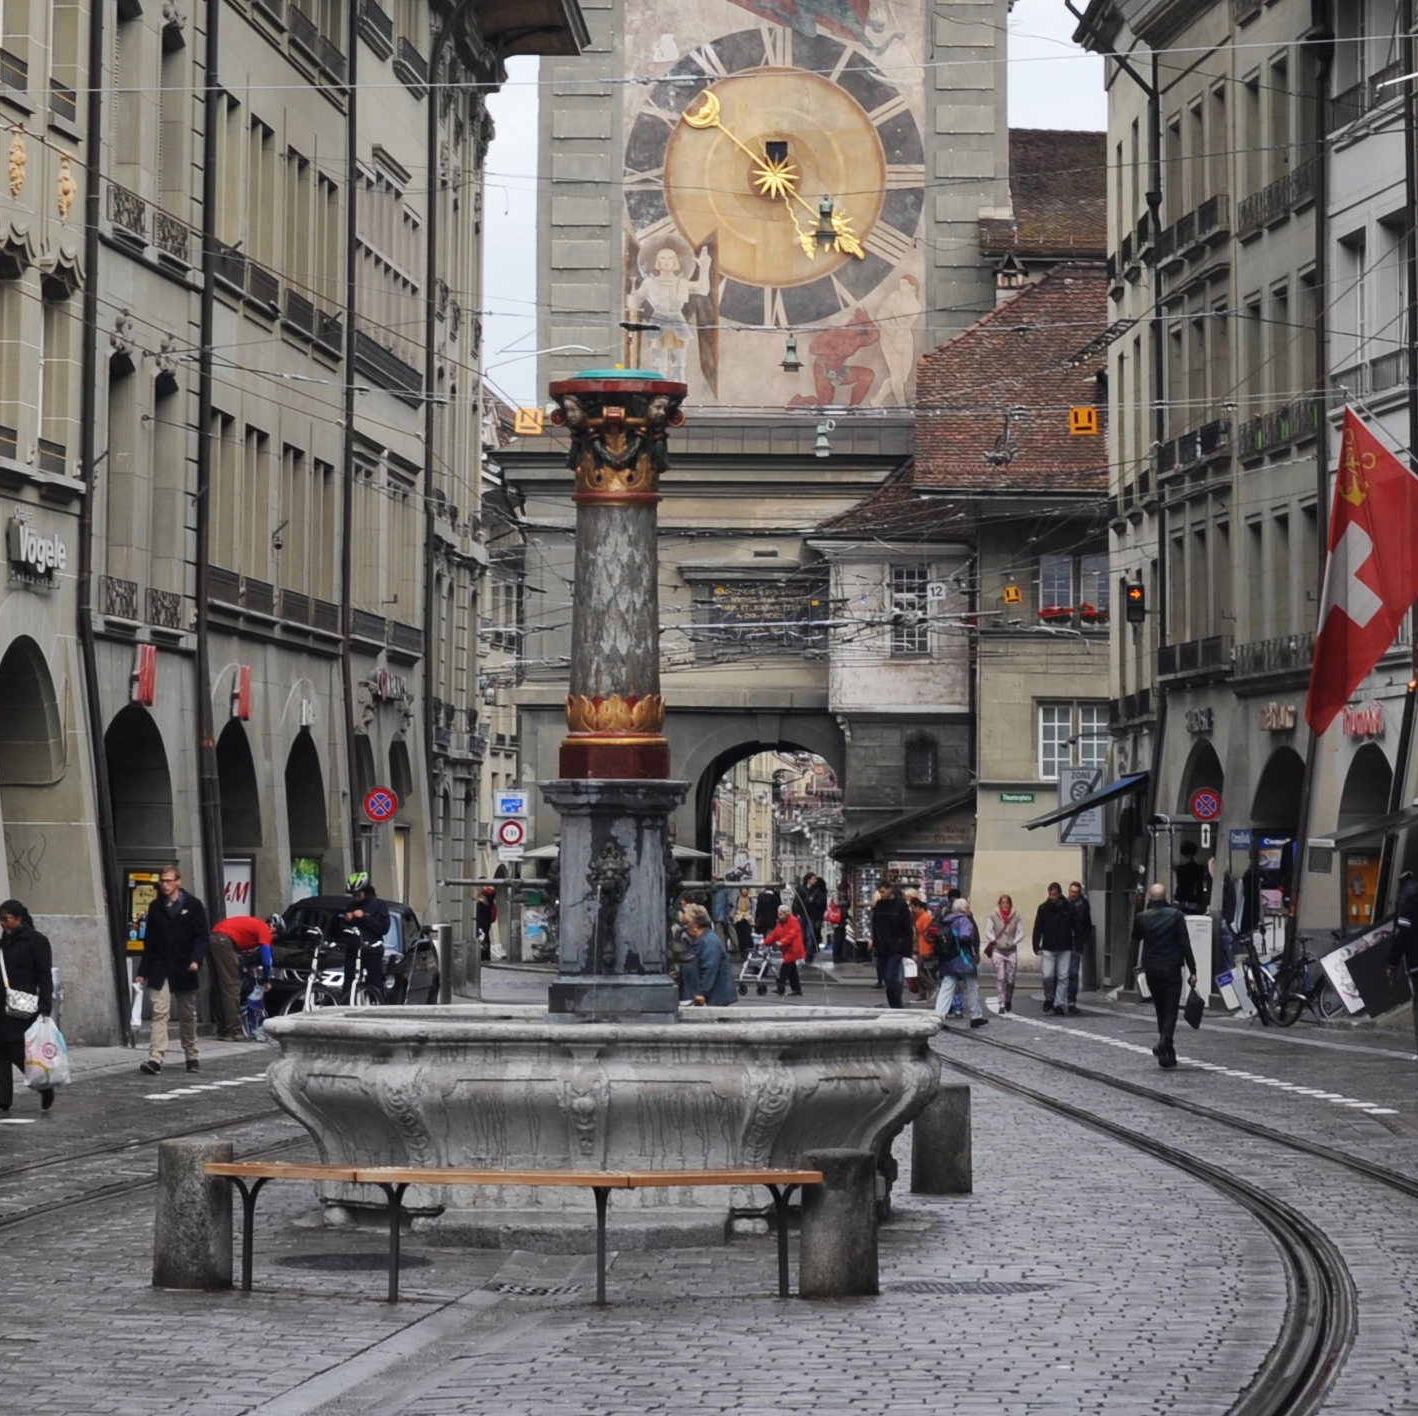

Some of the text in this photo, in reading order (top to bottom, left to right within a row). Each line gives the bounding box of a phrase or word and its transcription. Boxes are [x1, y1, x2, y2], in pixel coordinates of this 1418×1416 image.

[19, 524, 67, 574] Vögele
[930, 586, 943, 597] 12
[1070, 771, 1092, 780] ZONE
